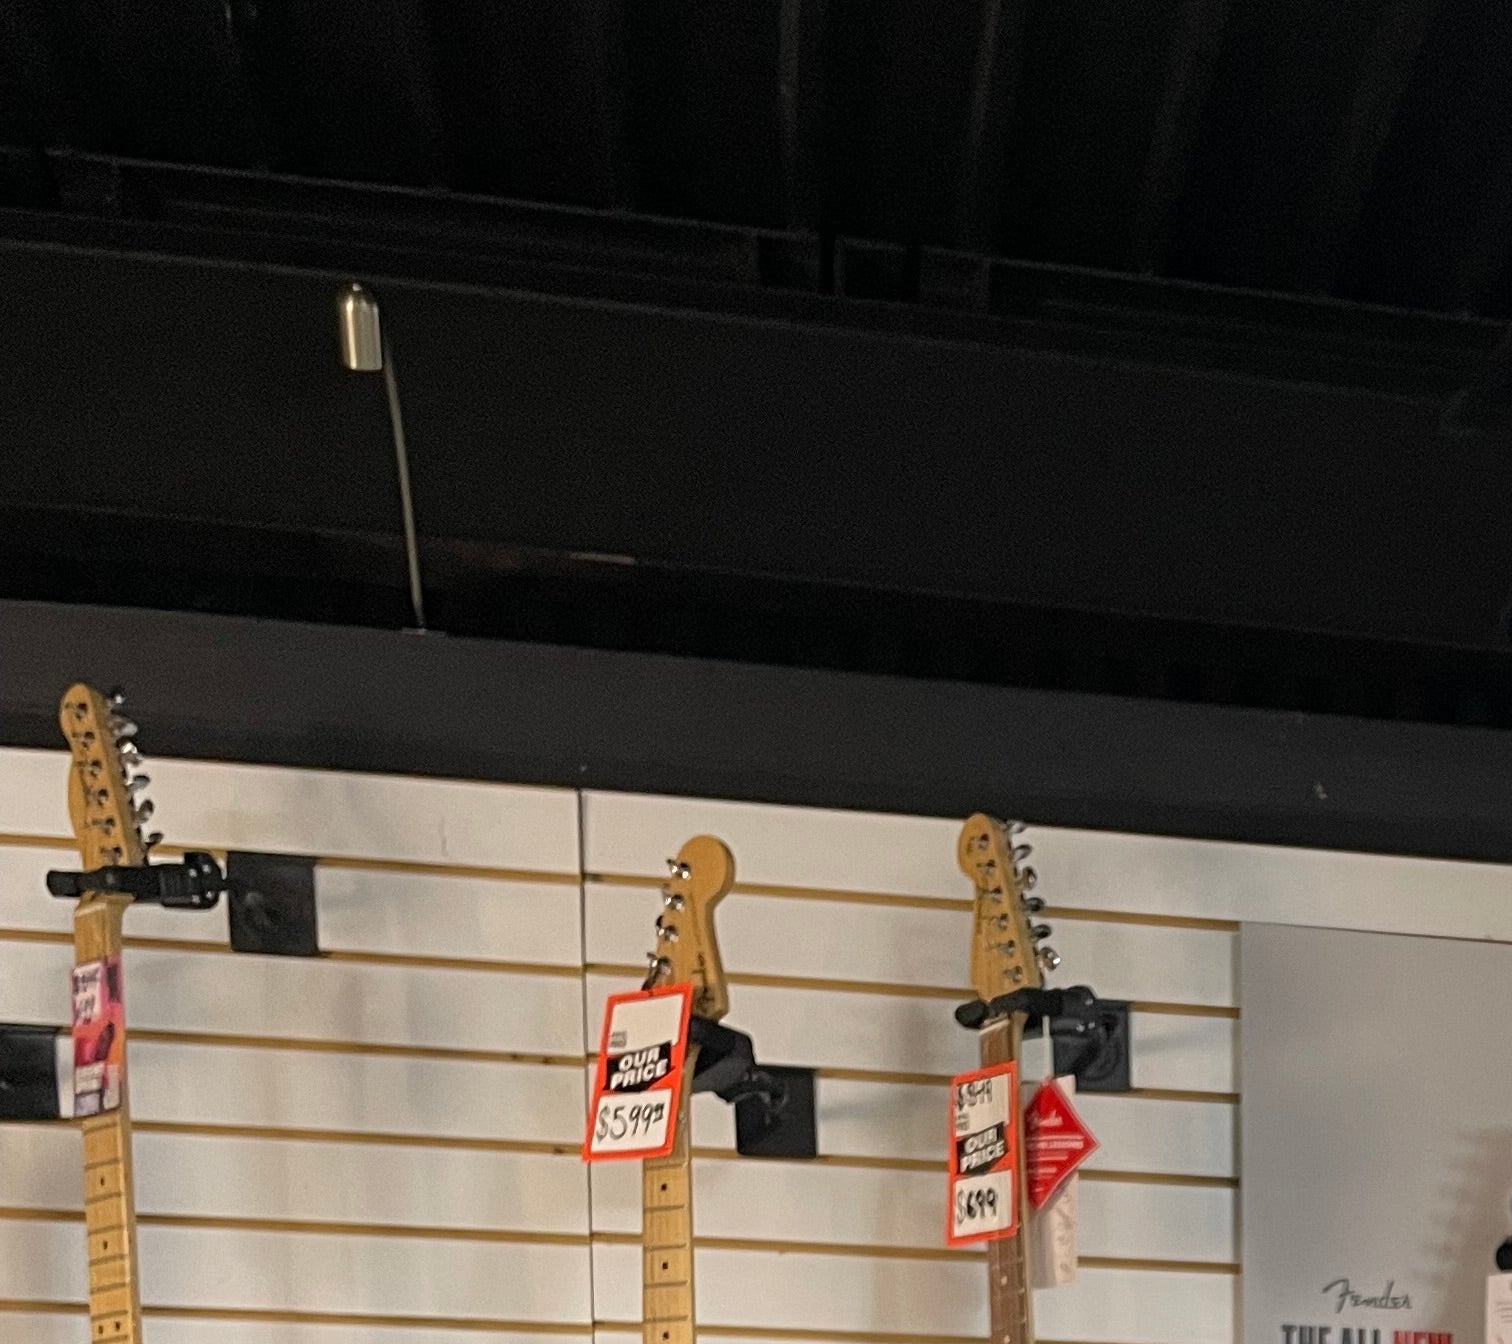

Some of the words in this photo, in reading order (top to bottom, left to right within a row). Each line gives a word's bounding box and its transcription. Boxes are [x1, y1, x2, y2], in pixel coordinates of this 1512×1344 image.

[610, 1058, 669, 1090] PRICE
[619, 1047, 661, 1071] OUR
[960, 1140, 1005, 1172] PRICE
[965, 1128, 998, 1154] OUR
[1322, 1278, 1413, 1313] Fender
